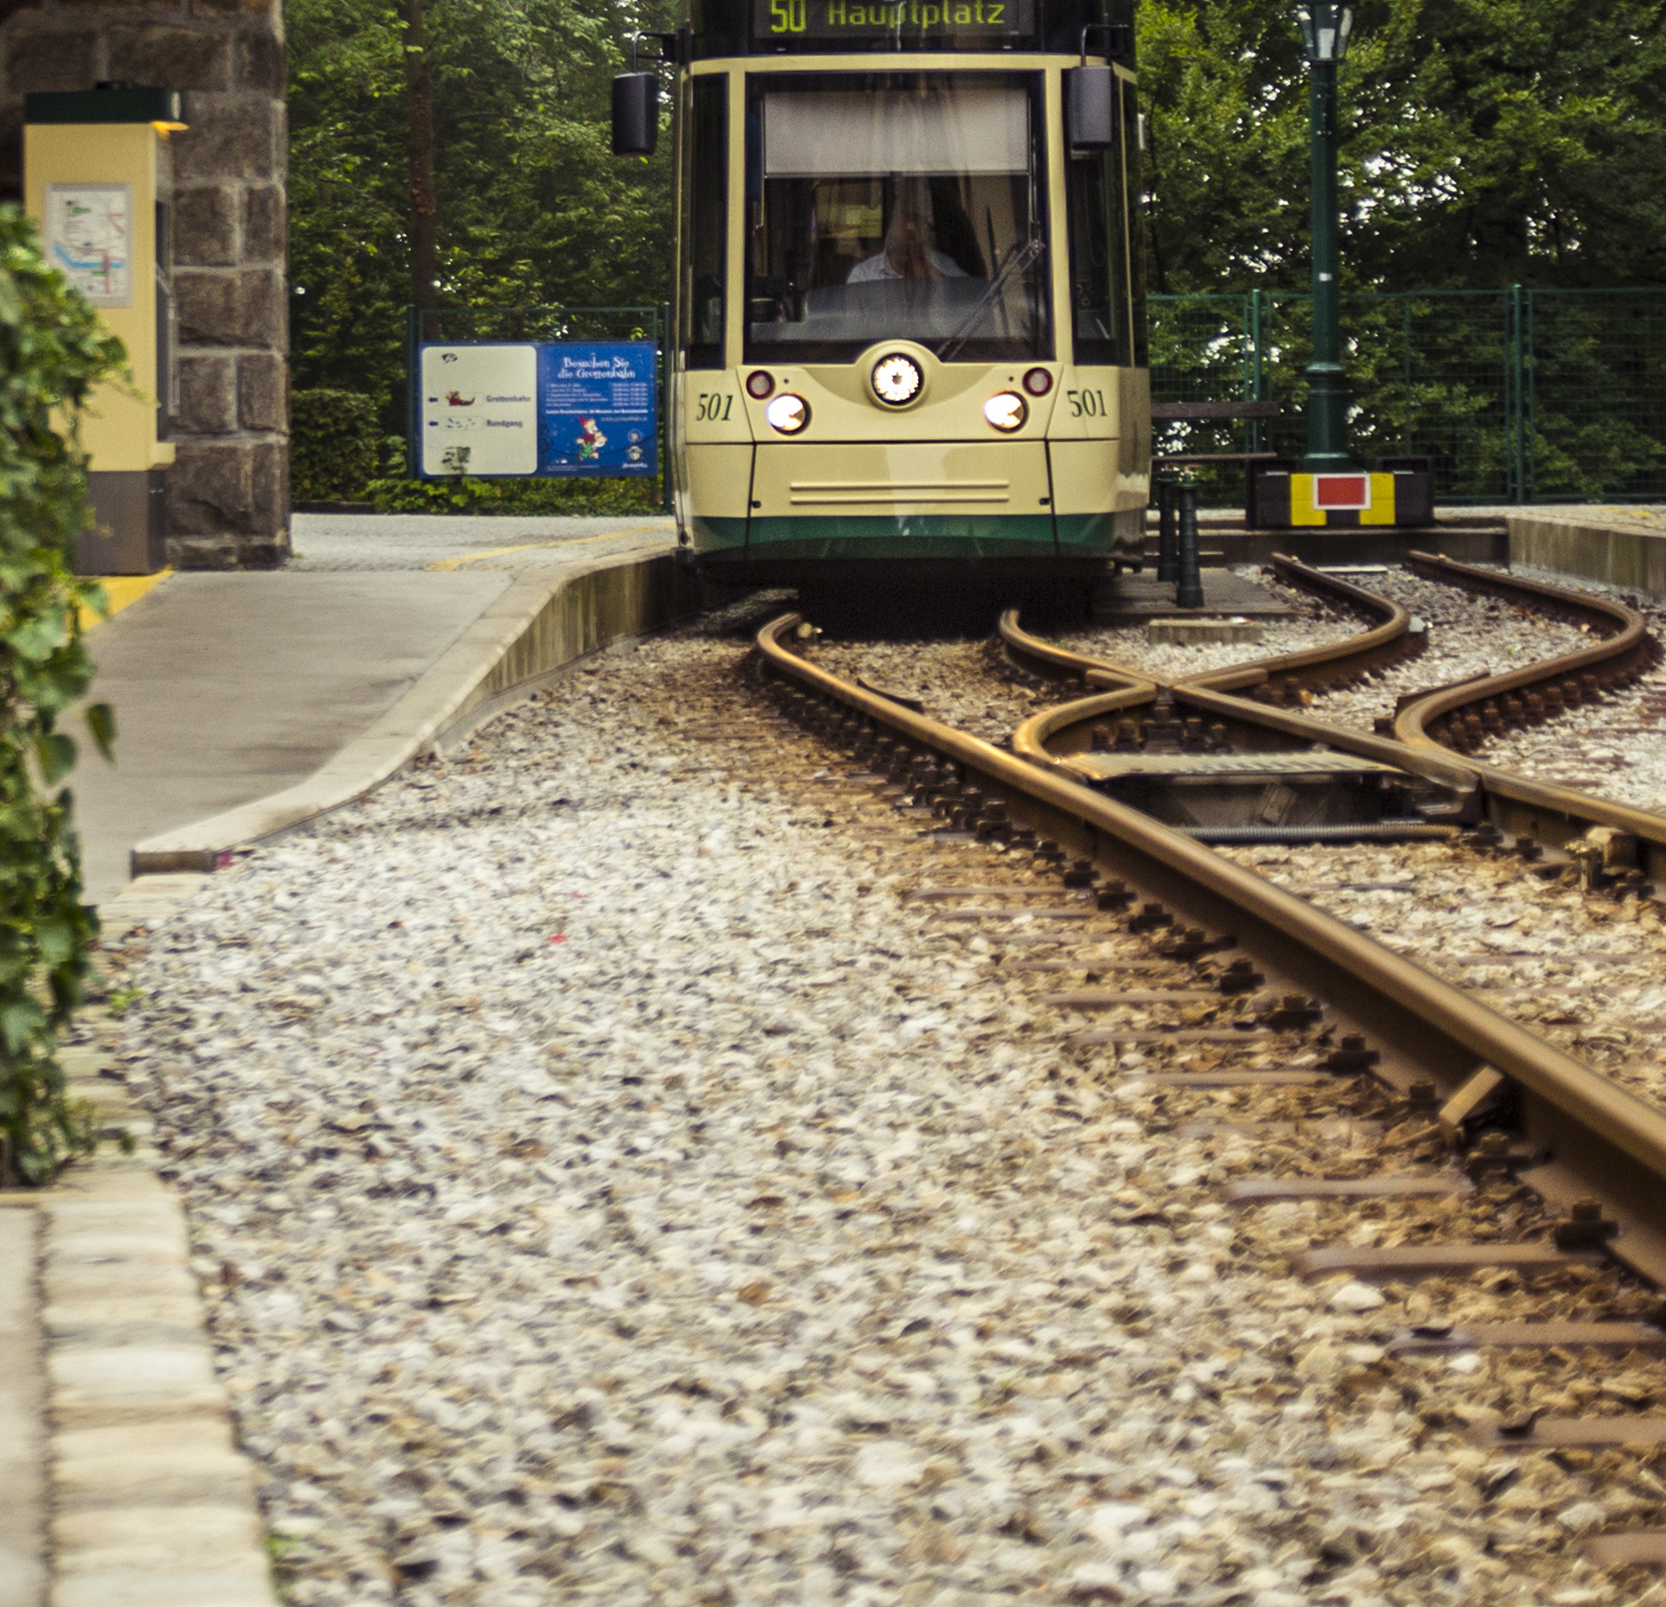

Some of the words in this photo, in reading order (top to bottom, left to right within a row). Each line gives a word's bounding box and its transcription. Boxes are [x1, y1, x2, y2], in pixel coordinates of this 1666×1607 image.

[613, 356, 630, 367] Sie
[557, 368, 573, 379] die
[486, 395, 531, 403] Grottenbahn
[1066, 389, 1107, 417] 501
[696, 393, 733, 421] 501
[486, 419, 523, 428] Rundgang
